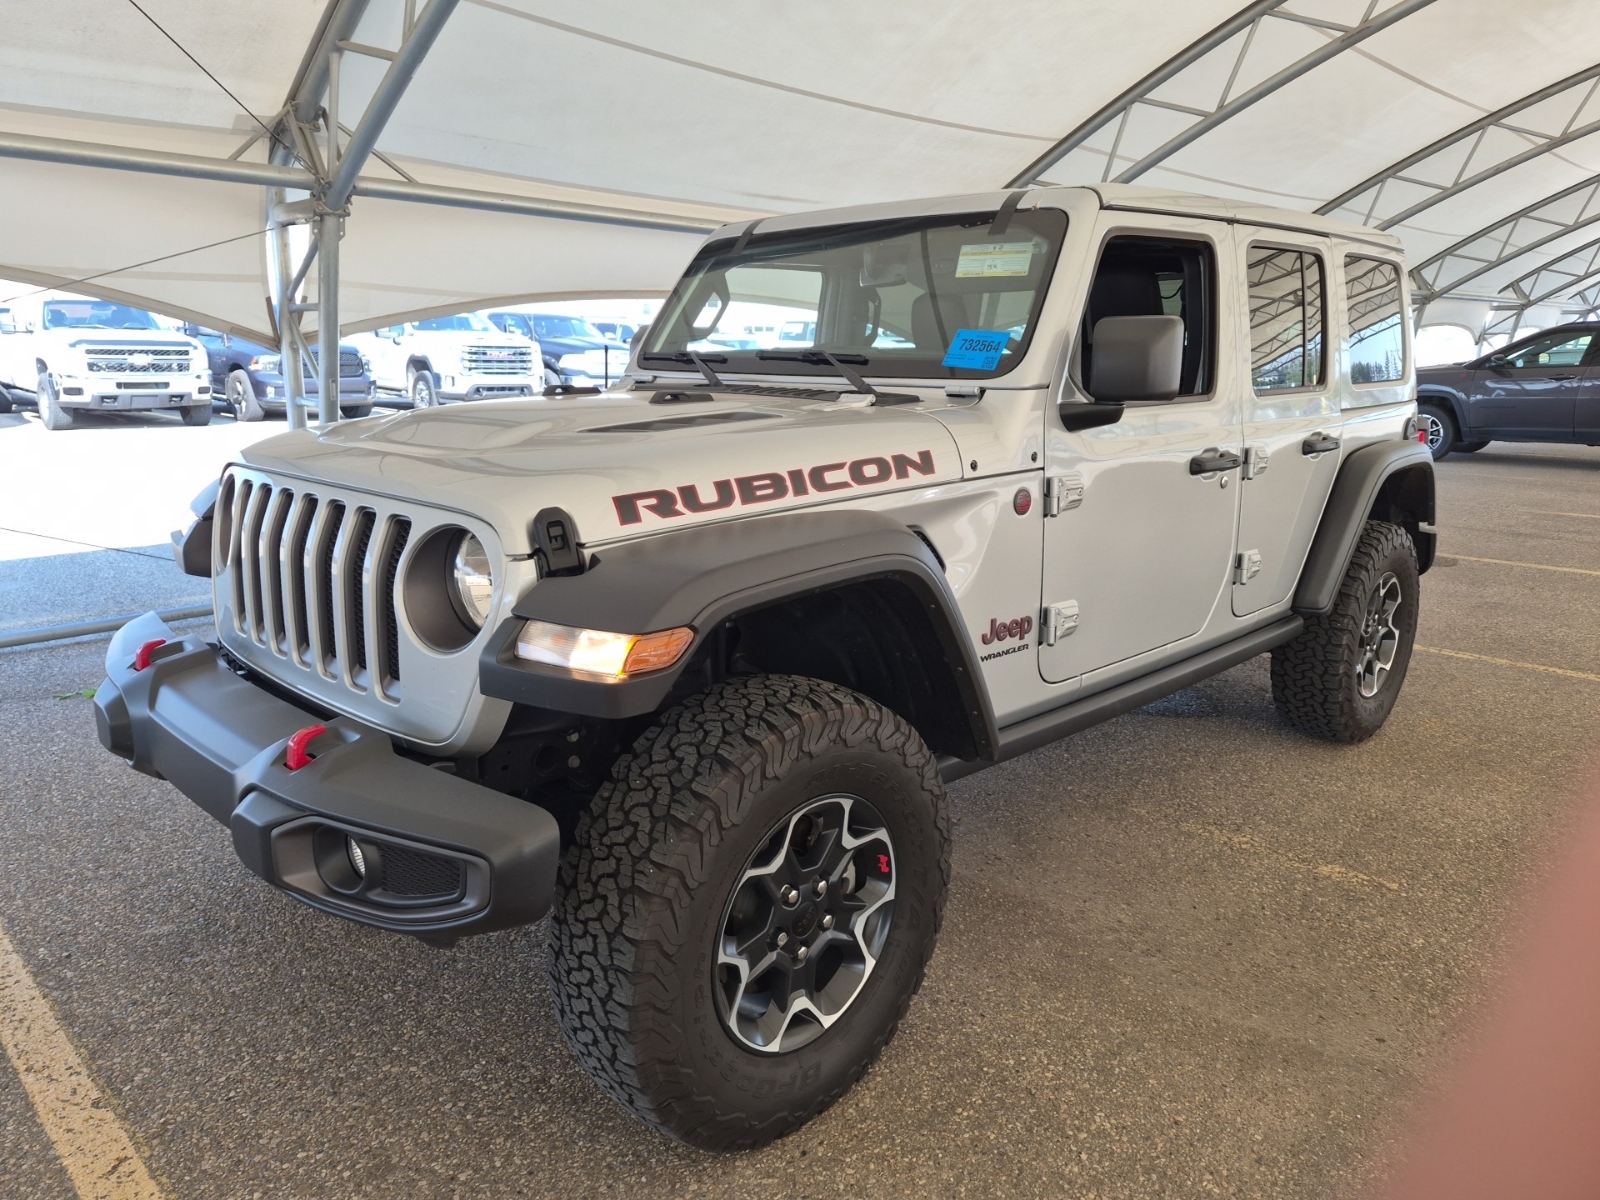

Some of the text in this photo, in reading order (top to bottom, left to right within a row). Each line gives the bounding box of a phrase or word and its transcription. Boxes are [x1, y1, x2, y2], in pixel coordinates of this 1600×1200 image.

[959, 338, 1003, 353] 732564
[611, 450, 935, 526] RUBICON
[982, 615, 1033, 645] Jeep
[980, 644, 1029, 662] WRANGLER
